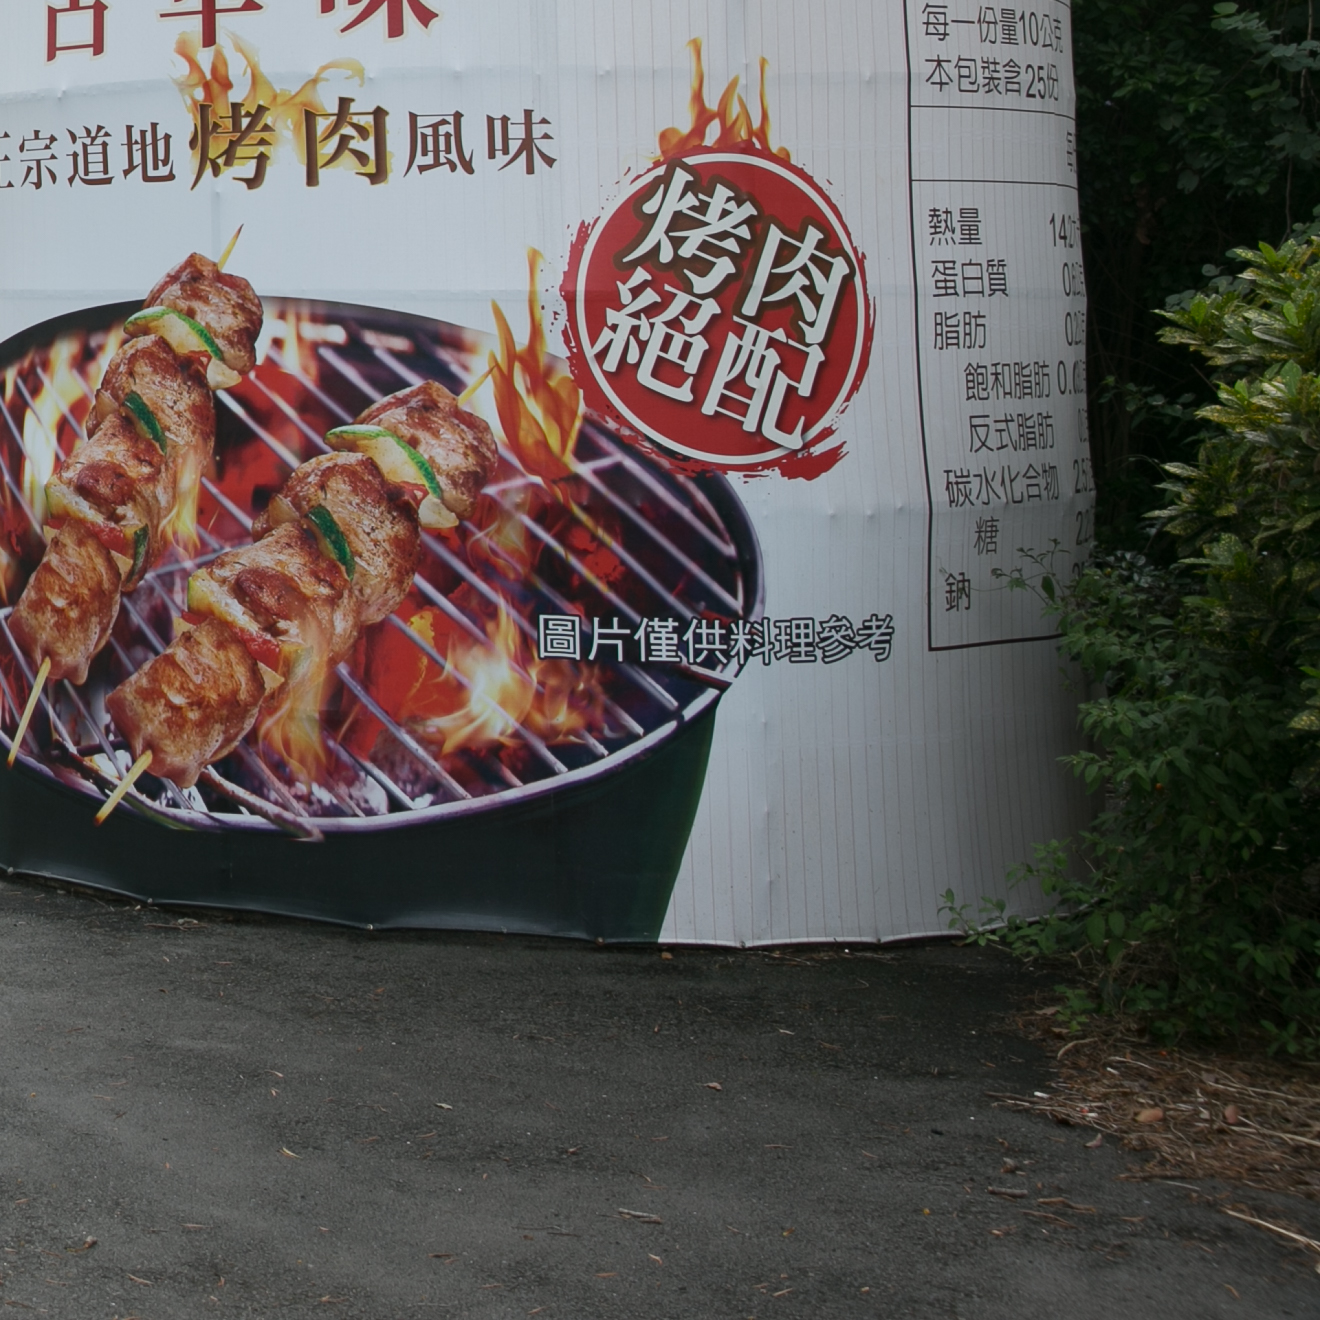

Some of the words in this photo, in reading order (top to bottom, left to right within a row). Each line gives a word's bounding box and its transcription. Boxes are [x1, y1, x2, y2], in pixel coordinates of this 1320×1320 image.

[922, 2, 1064, 53] 每一份量10公克
[925, 54, 1059, 101] 本包裝含25份
[928, 207, 983, 246] 熱量
[621, 159, 850, 345] 烤肉
[931, 259, 1009, 298] 蛋白質
[933, 310, 986, 350] 脂肪
[592, 269, 825, 450] 絕配
[963, 360, 1051, 401] 飽和脂肪
[969, 412, 1054, 453] 反式脂肪
[943, 462, 1059, 508] 碳水化合物
[973, 516, 1000, 556] 糖
[944, 572, 971, 612] 鈉
[536, 612, 895, 665] 圖片僅供料理參考
